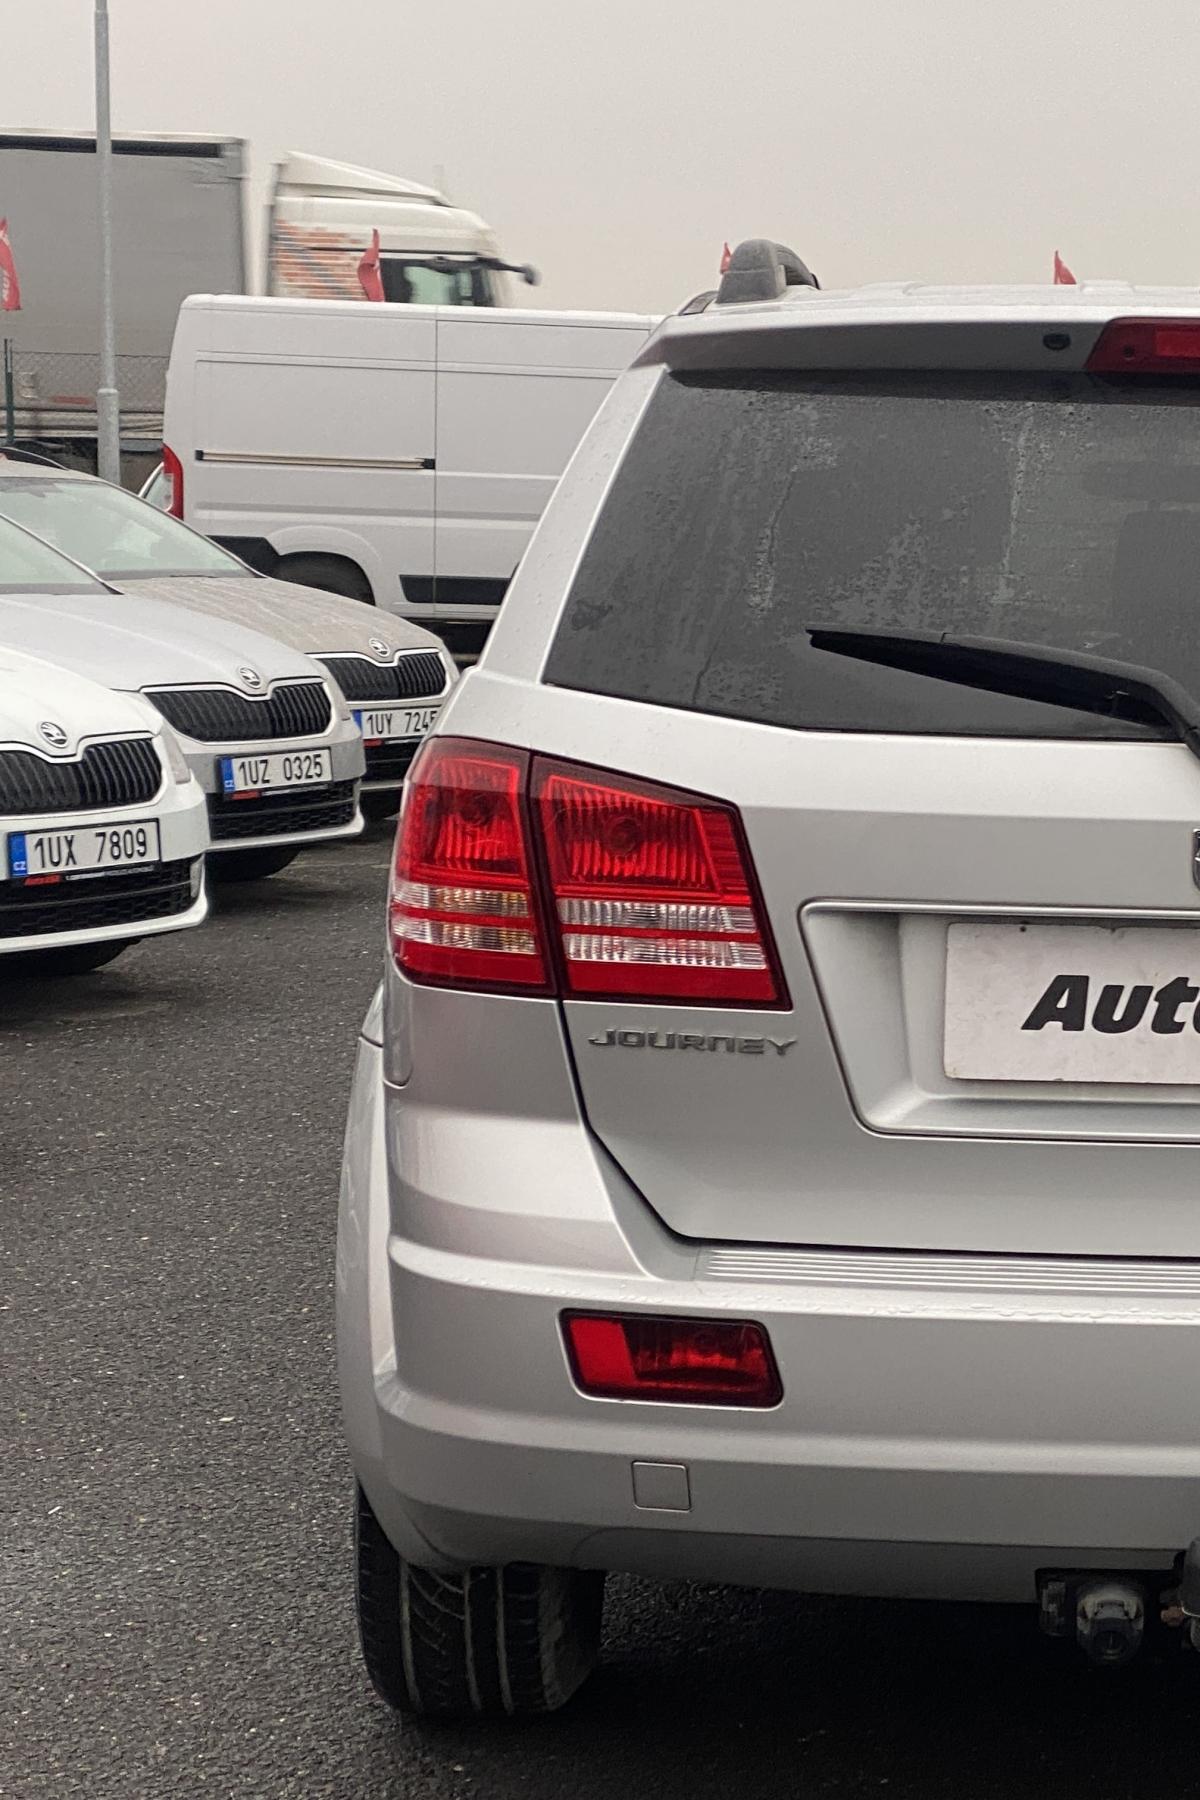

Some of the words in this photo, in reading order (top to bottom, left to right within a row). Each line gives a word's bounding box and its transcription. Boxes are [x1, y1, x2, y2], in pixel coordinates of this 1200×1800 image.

[367, 713, 393, 735] 1UY
[239, 759, 271, 786] 1UZ
[283, 753, 322, 781] 0325
[34, 835, 77, 869] 1UX
[95, 828, 147, 863] 7809
[13, 861, 27, 871] CZ
[588, 1028, 798, 1056] JOURNEY
